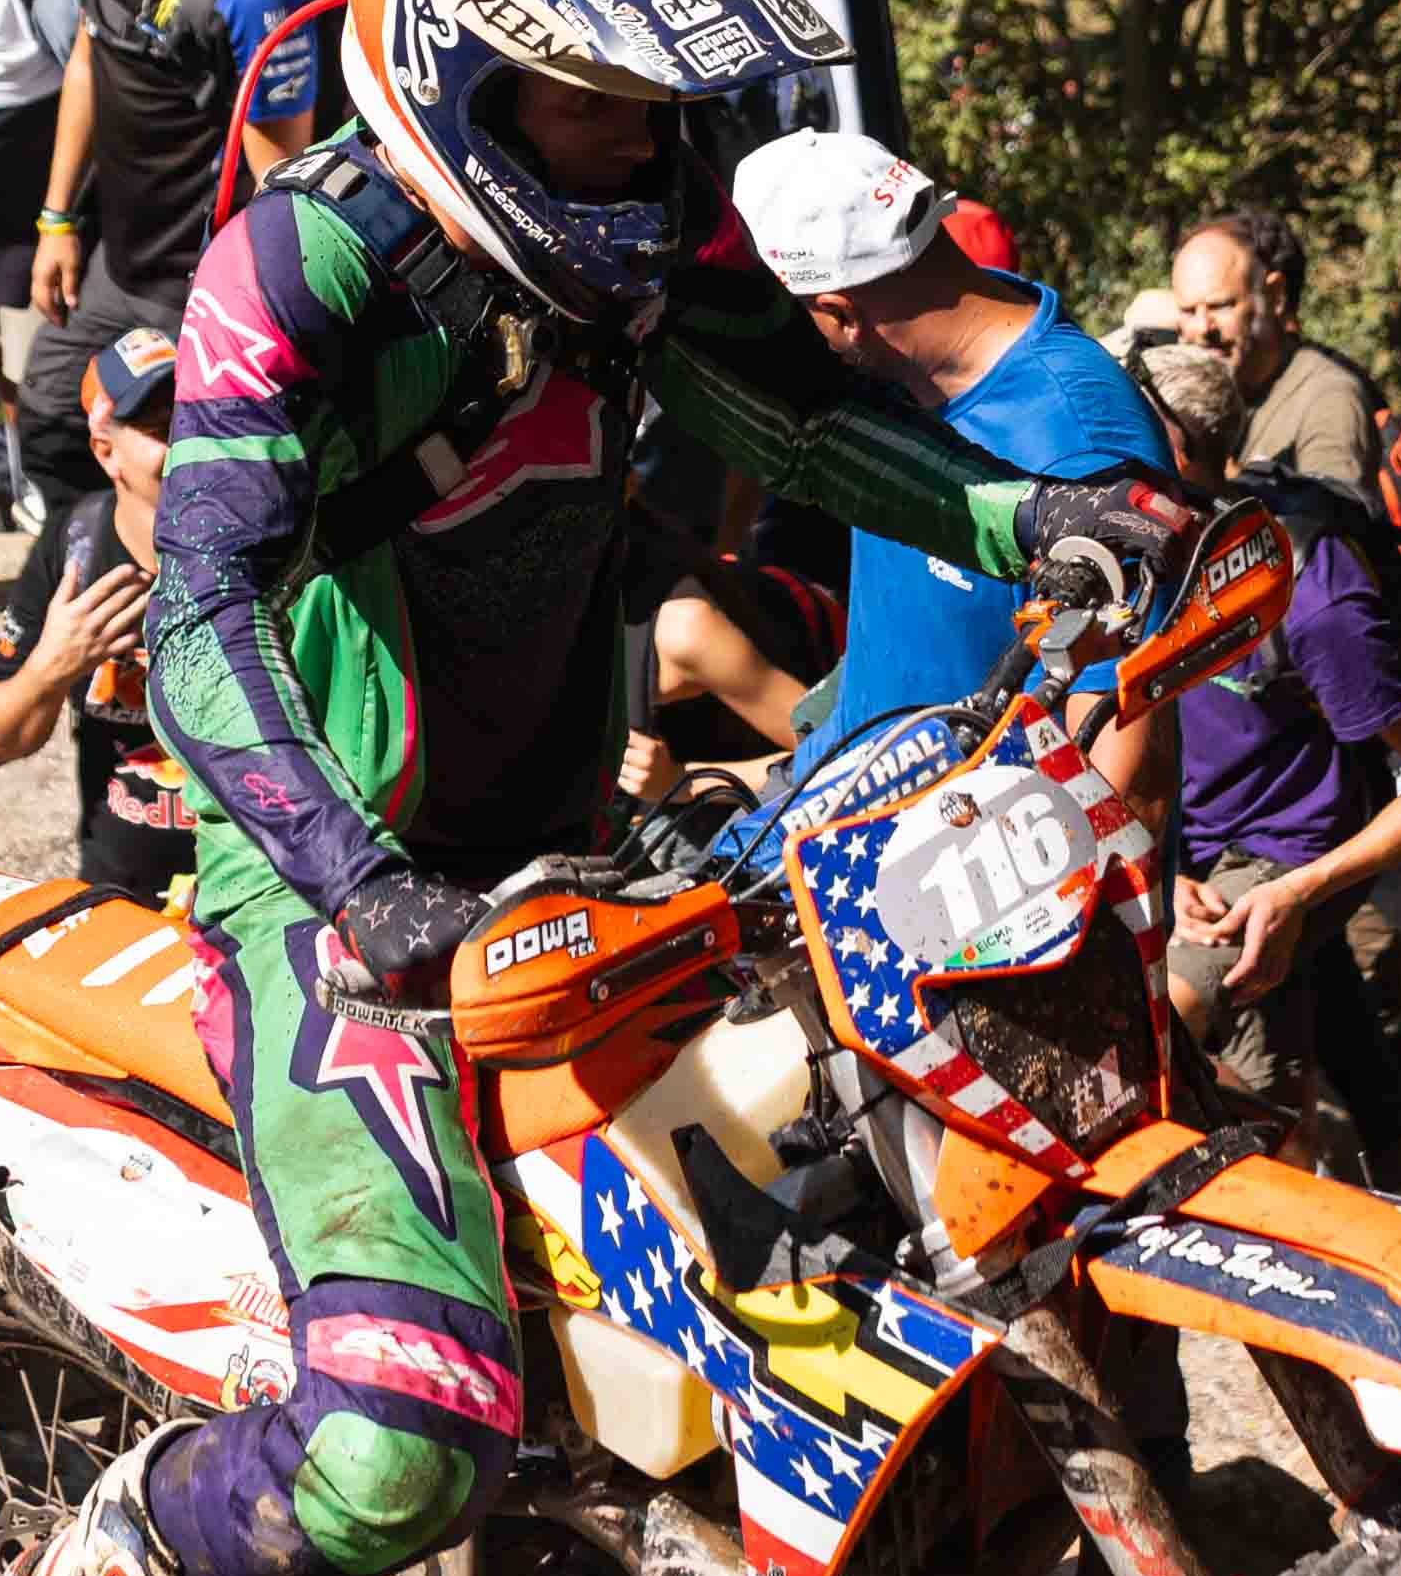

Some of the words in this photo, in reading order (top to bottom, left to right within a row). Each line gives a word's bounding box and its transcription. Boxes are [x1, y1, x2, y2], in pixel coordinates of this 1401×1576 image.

[485, 178, 555, 248] seaspan
[108, 778, 172, 828] Red
[919, 793, 1071, 939] 116
